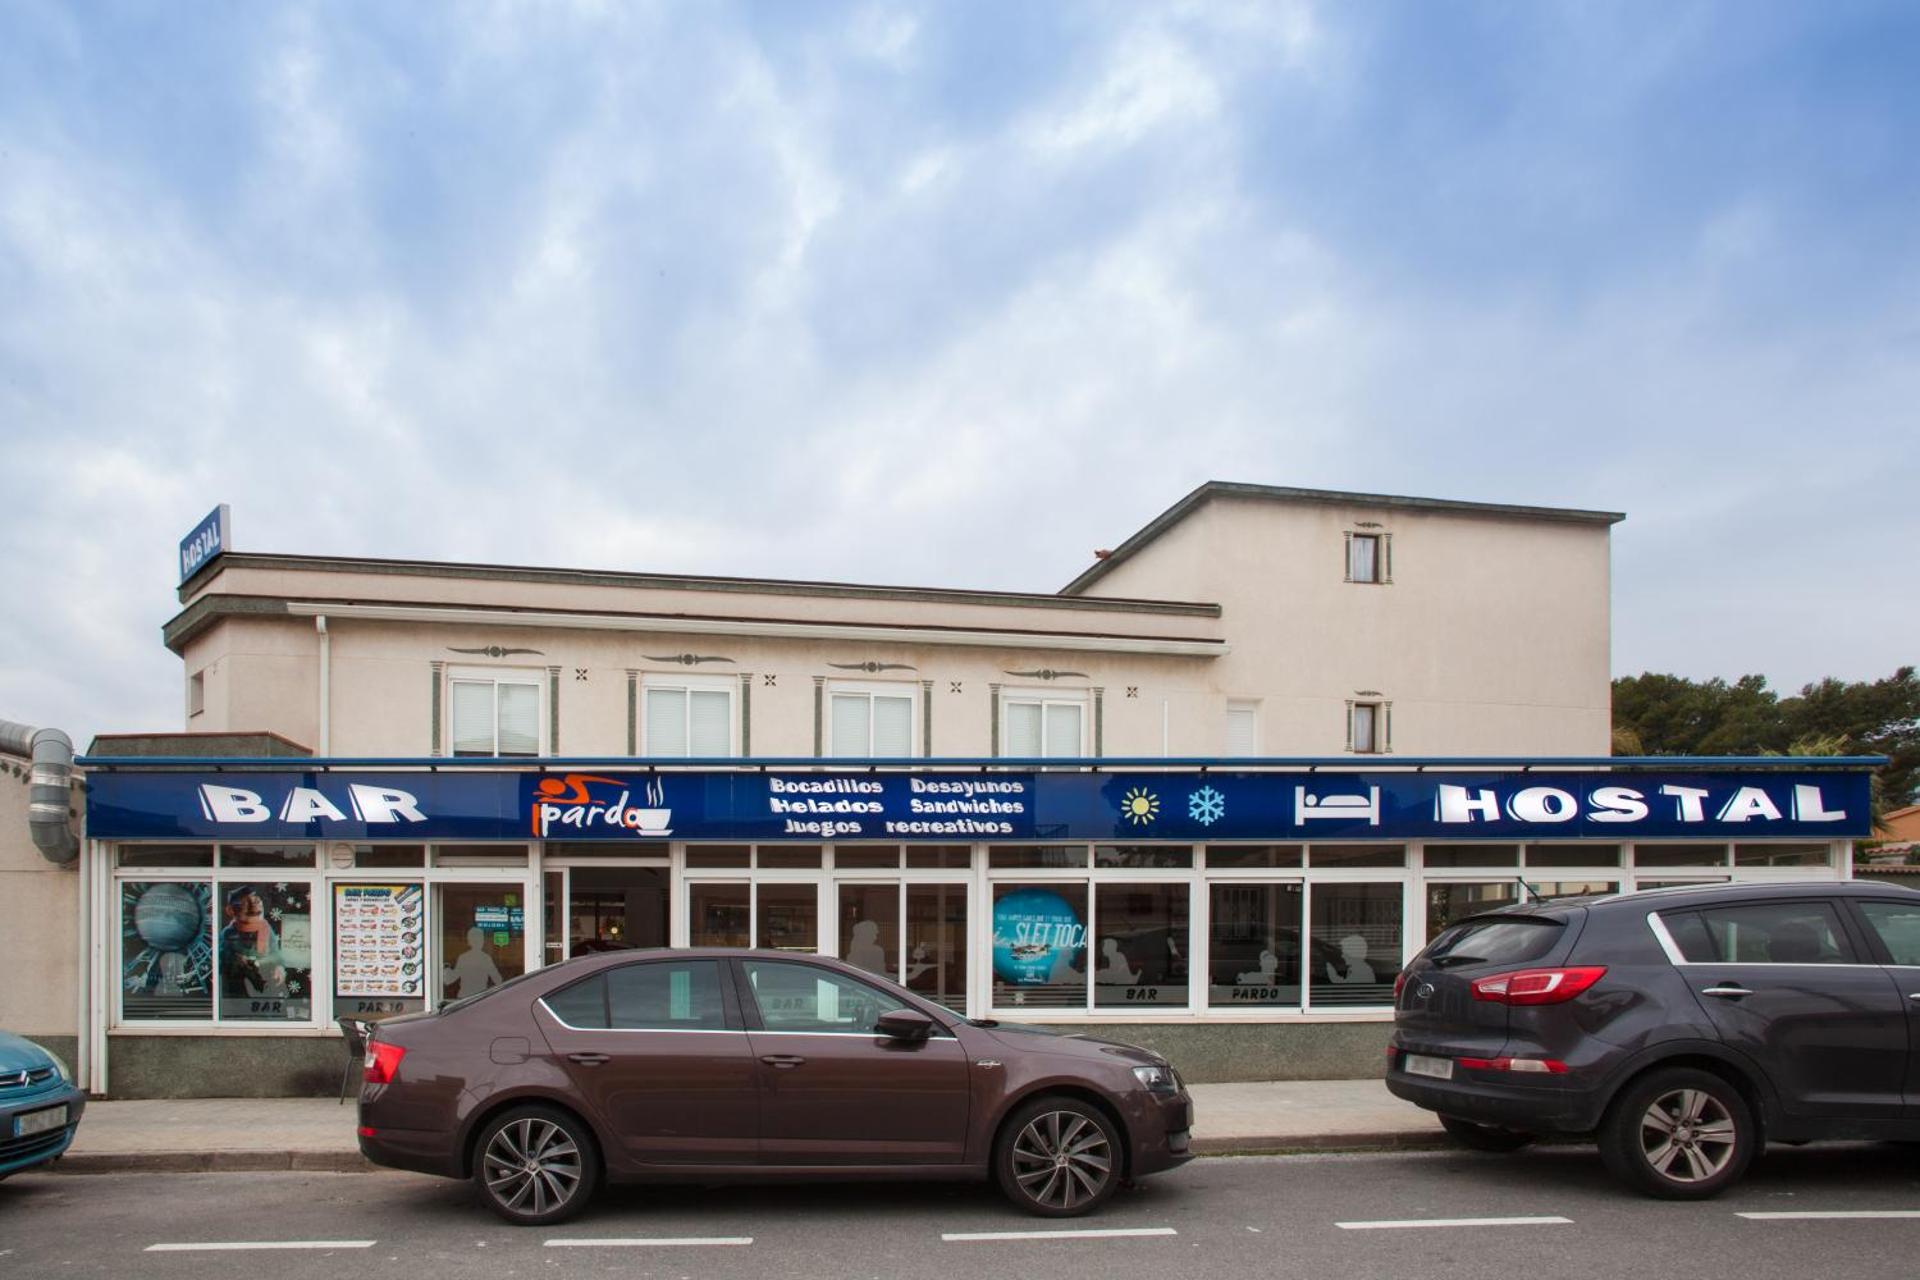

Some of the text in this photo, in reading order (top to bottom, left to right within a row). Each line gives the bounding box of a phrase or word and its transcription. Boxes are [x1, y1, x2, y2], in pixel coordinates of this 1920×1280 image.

[182, 522, 220, 574] HOSTAL
[769, 777, 1024, 797] Bocadillos Desayunos
[198, 784, 429, 823] BAR
[769, 797, 1024, 813] Helados Sandwiches
[1433, 784, 1847, 823] HOSTAL
[533, 790, 640, 838] pardo
[784, 819, 1013, 837] Juegos recreativos
[1126, 989, 1158, 1000] BAR
[1231, 988, 1279, 999] PARDO
[251, 1001, 282, 1013] BAR
